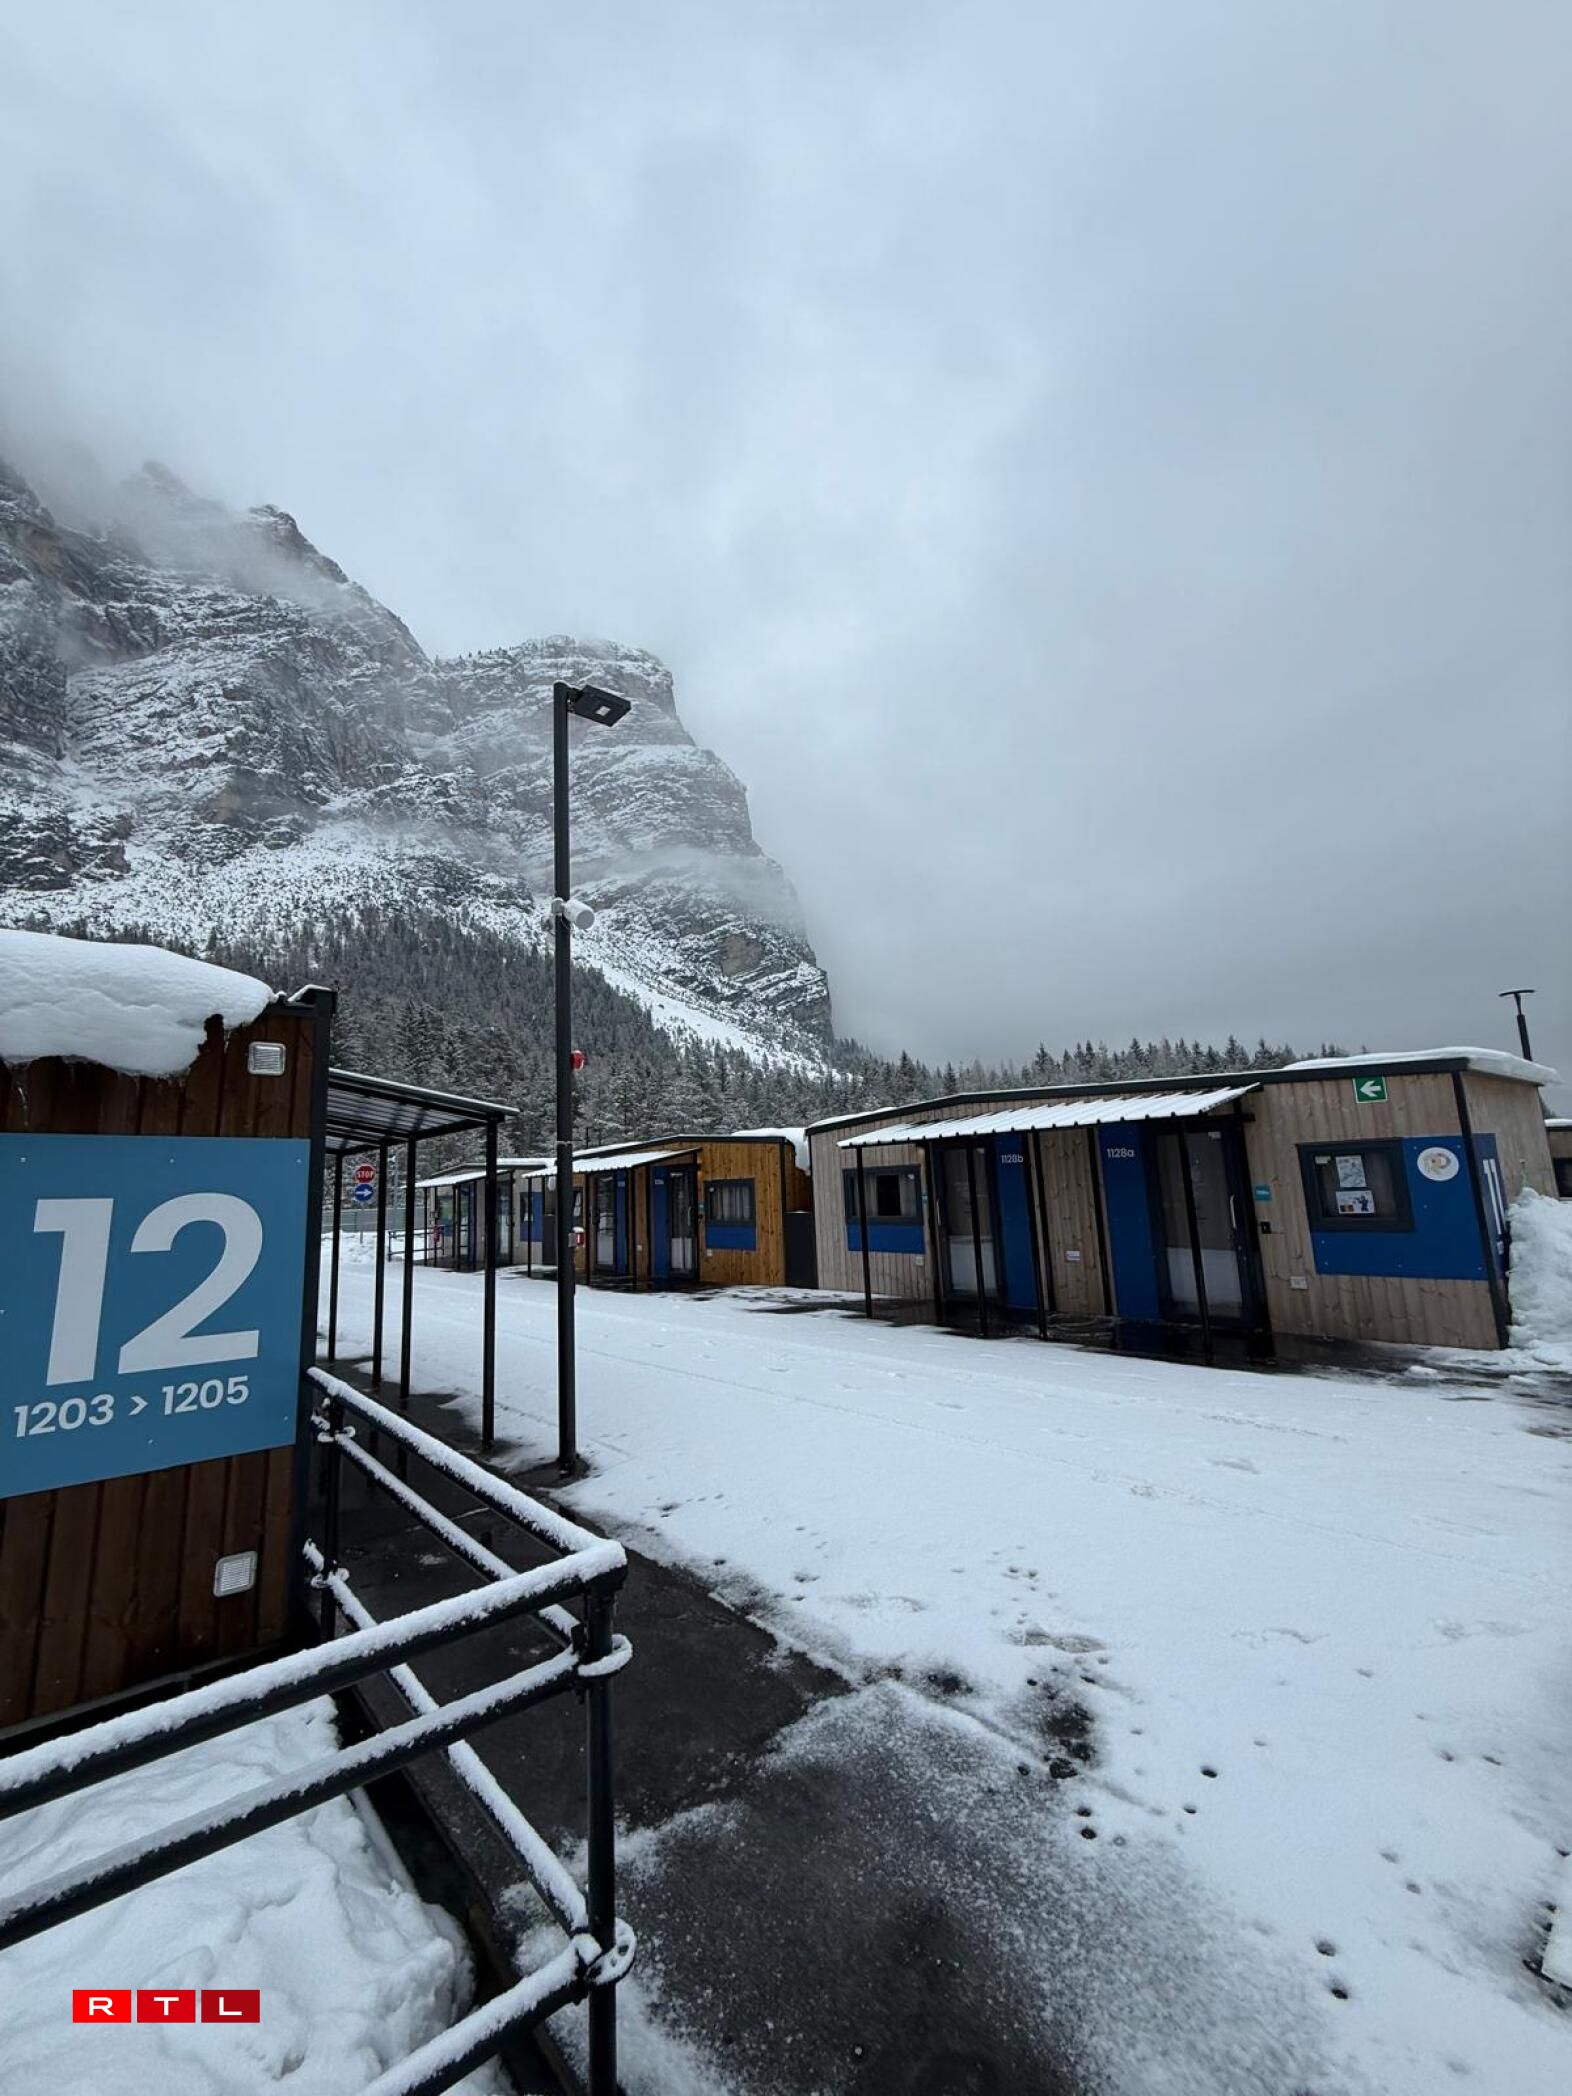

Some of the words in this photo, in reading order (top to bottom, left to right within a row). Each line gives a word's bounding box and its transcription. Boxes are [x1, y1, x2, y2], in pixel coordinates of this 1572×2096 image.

[1106, 1147, 1135, 1158] 1128a
[33, 1192, 263, 1386] 12
[13, 1394, 115, 1438] 1203
[162, 1375, 249, 1415] 1205
